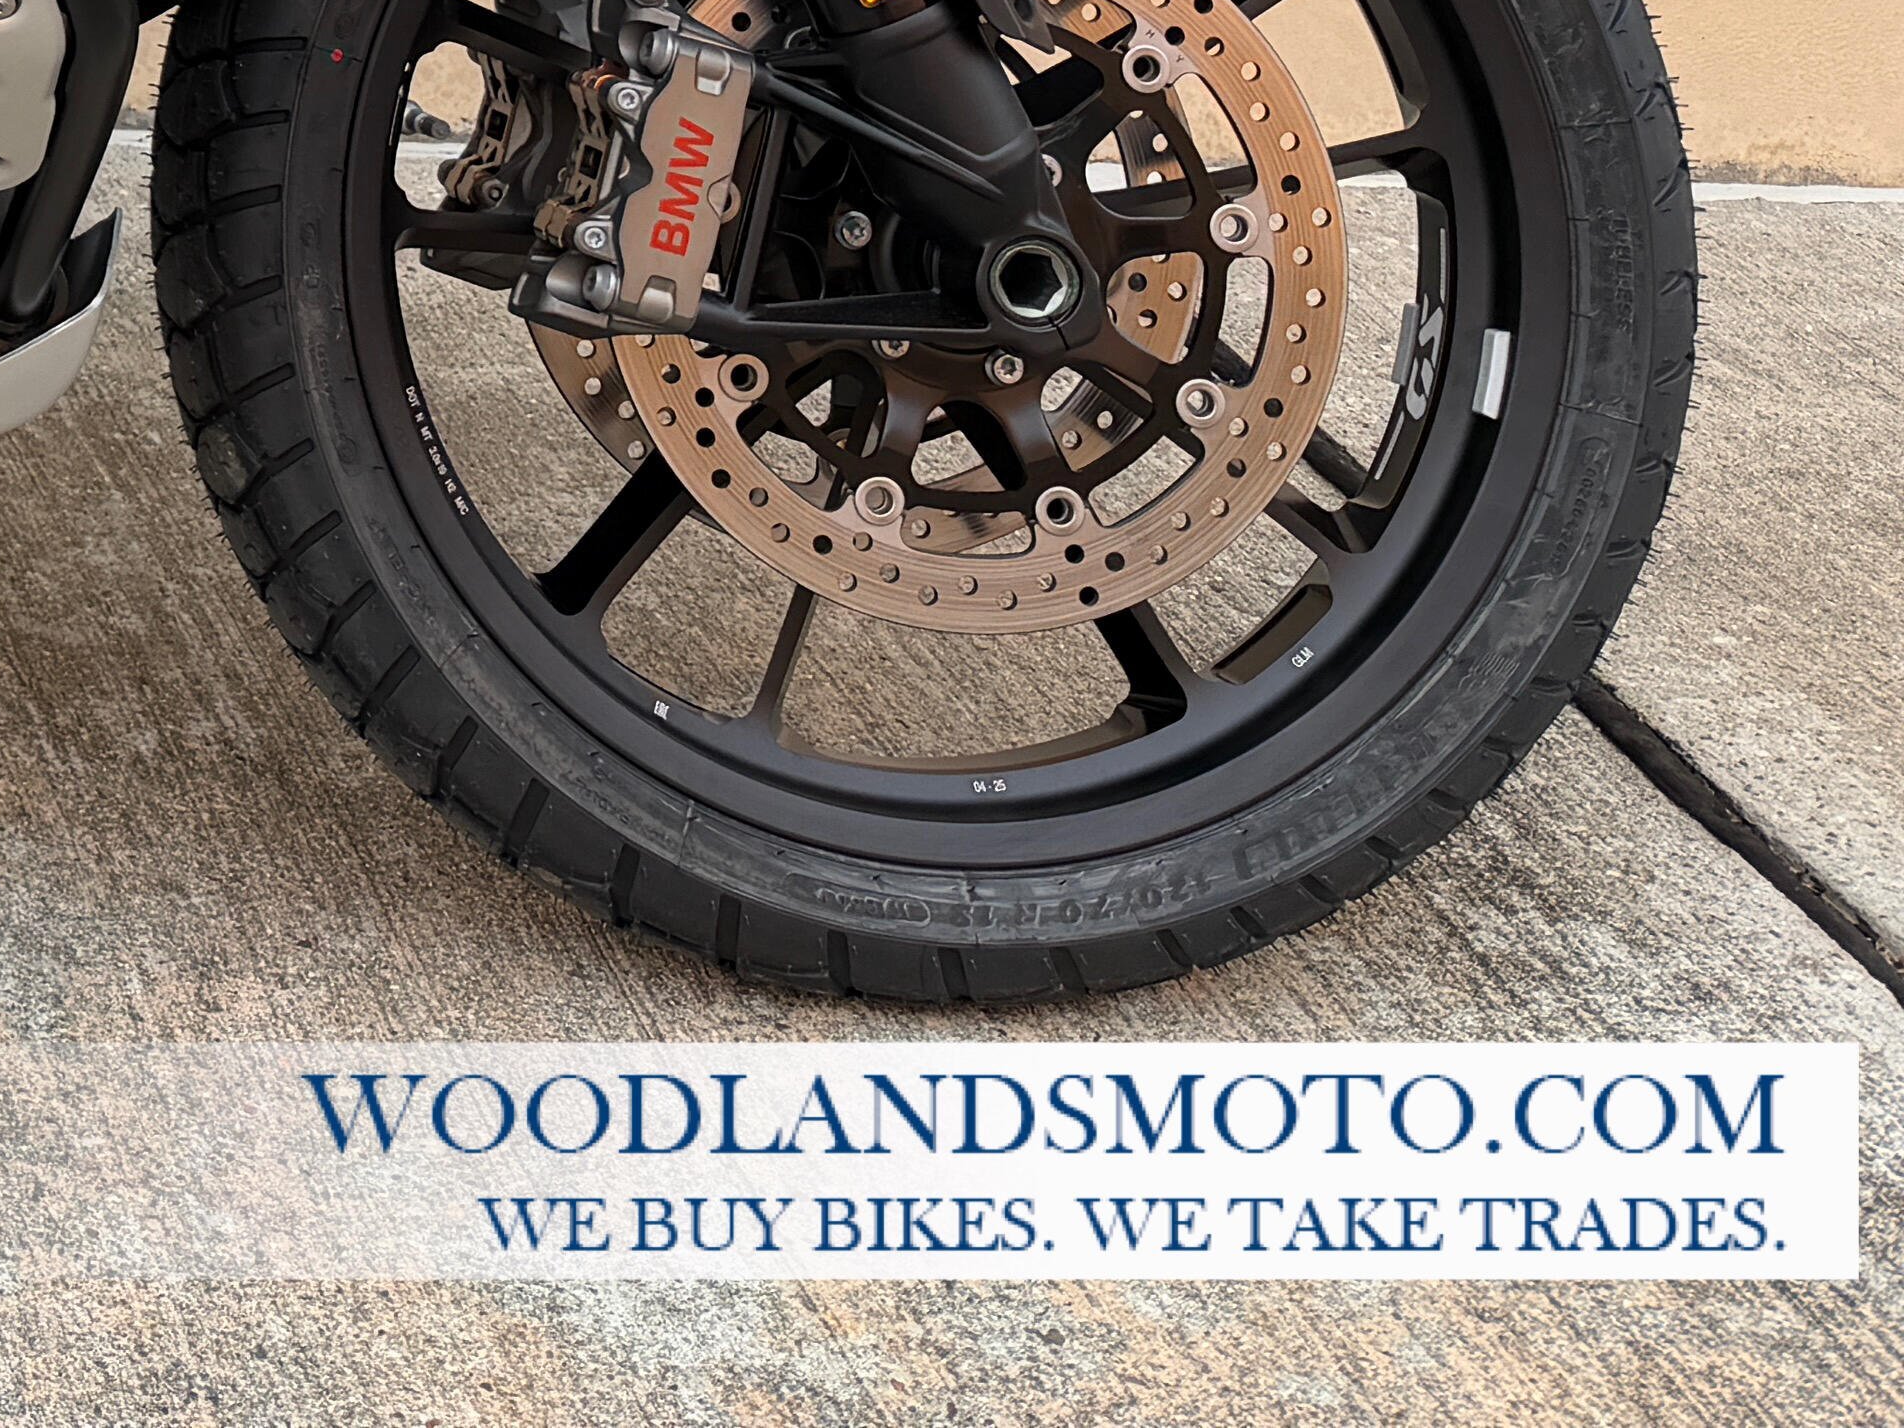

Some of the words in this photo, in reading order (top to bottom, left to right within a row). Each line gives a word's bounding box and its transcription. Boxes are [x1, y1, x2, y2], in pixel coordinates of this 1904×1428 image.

[649, 115, 715, 257] BMW
[406, 385, 421, 408] DOT
[420, 426, 434, 441] MT
